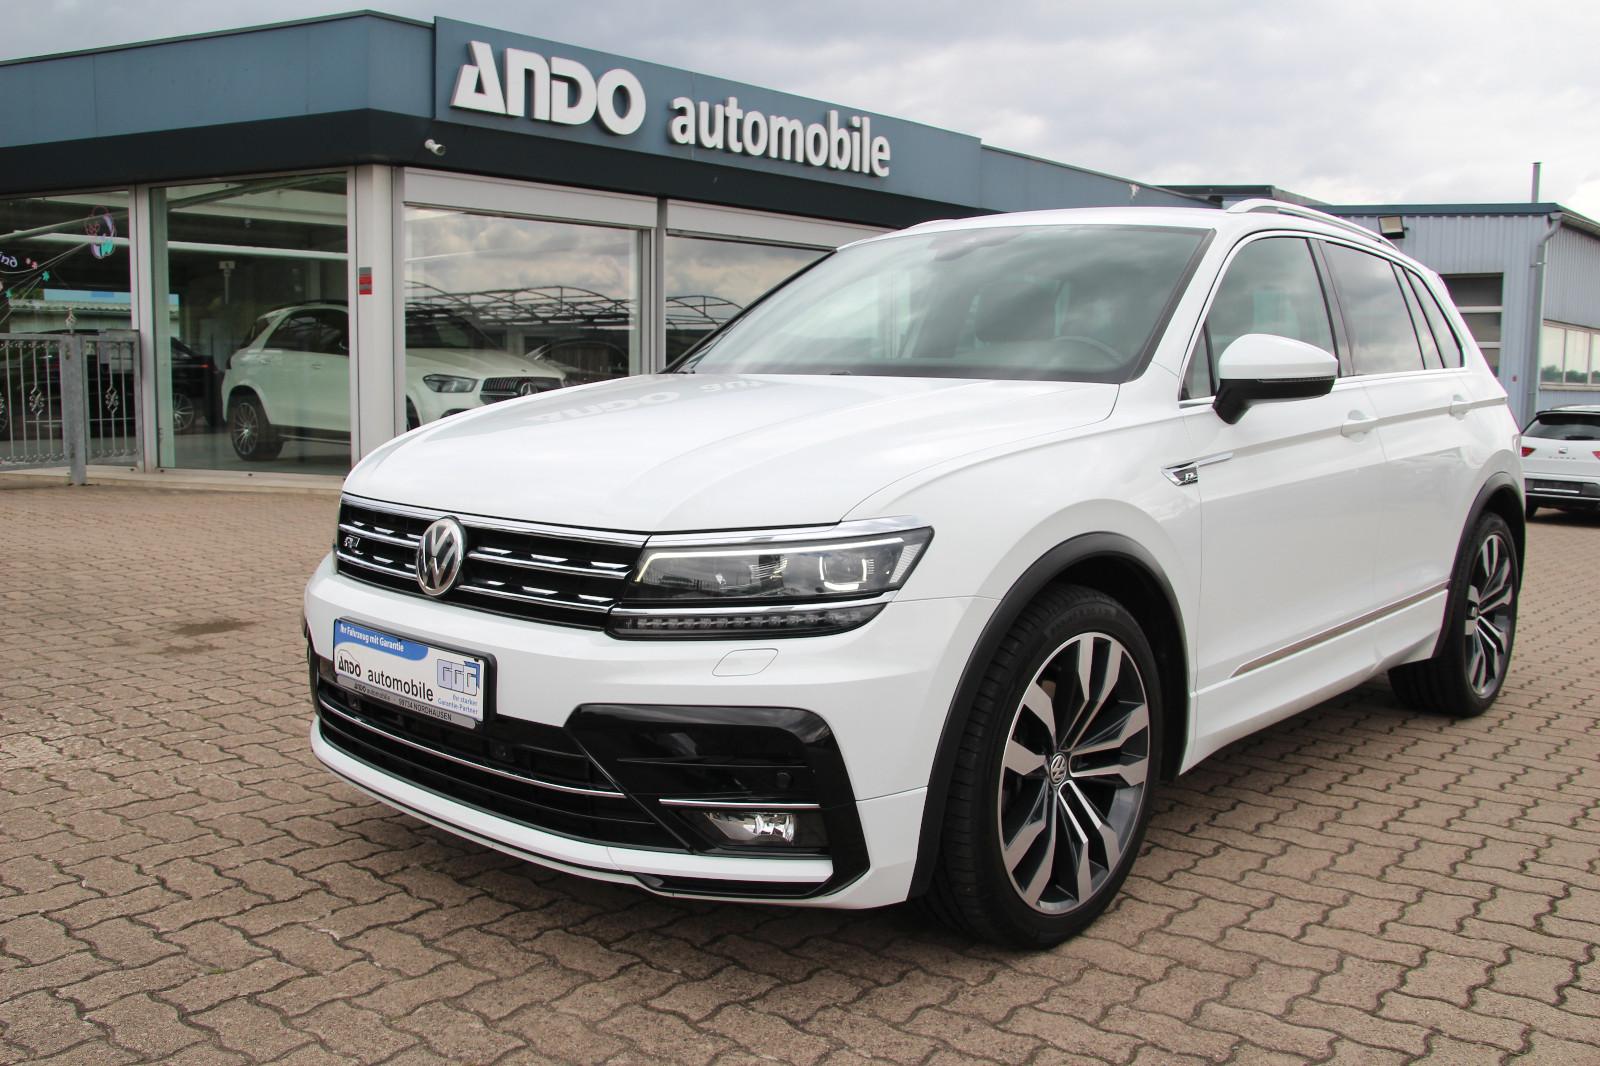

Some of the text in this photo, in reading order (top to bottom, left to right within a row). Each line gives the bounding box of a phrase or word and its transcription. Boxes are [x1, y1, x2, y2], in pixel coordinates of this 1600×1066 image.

[450, 40, 891, 177] ANDO automobile
[369, 634, 379, 645] mit
[379, 637, 405, 652] Garantie
[338, 655, 434, 702] ANDO automobile
[413, 702, 452, 721] NORDHAUSEN
